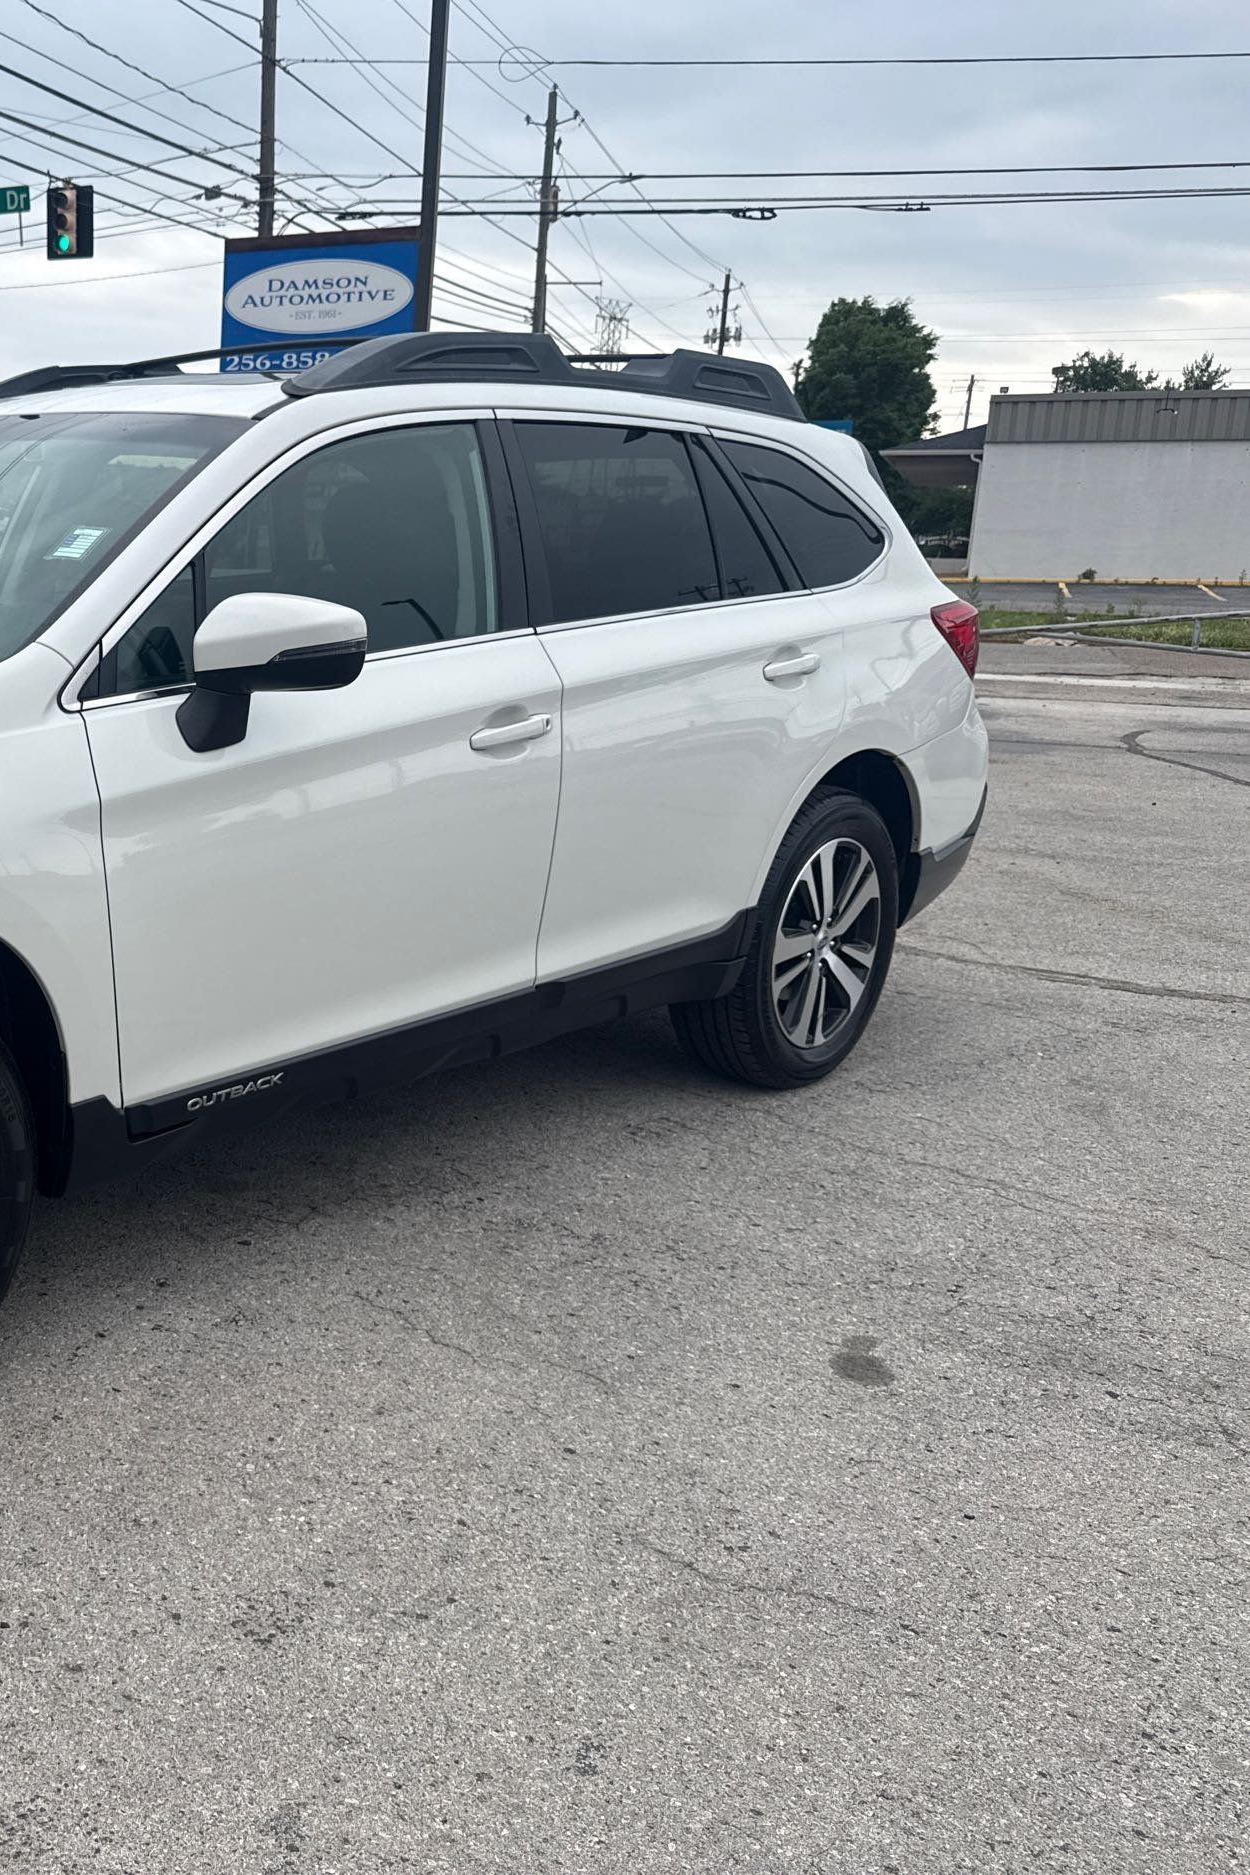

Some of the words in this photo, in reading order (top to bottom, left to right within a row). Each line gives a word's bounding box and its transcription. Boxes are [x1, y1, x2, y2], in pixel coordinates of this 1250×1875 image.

[6, 191, 27, 210] Dr
[268, 276, 369, 293] DAMSON
[241, 289, 395, 309] AUTOMOTIVE
[187, 1072, 284, 1111] OUTBACK
